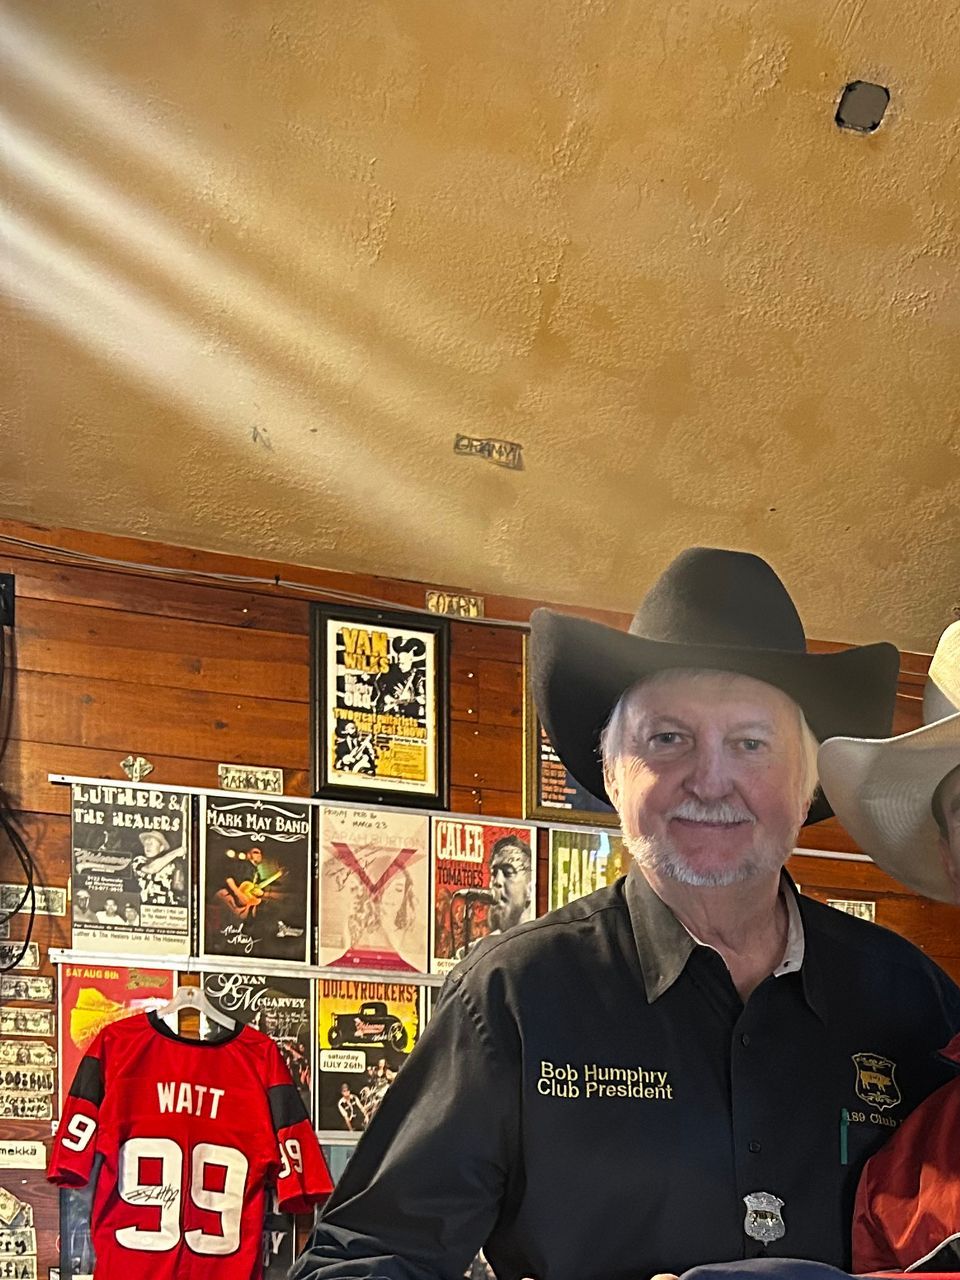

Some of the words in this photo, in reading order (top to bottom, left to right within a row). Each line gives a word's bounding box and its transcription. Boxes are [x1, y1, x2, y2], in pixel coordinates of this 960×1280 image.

[341, 627, 388, 657] VAN
[343, 652, 389, 673] WILKS
[73, 783, 165, 809] LUTHER
[168, 795, 180, 810] &
[74, 808, 104, 825] THE
[112, 811, 180, 832] HEALERS
[206, 809, 242, 828] MARK
[246, 813, 272, 832] MAY
[275, 816, 309, 835] BAND
[436, 821, 484, 864] CALEB
[437, 865, 484, 888] TOMATOES
[66, 968, 82, 977] SAT
[84, 968, 103, 979] AUG
[204, 973, 266, 1002] RYAN
[322, 980, 414, 1002] DOLLYROCKERS
[322, 1060, 342, 1069] JULY
[343, 1061, 364, 1070] 26th
[327, 1051, 359, 1061] saturday
[541, 1060, 578, 1081] Bob
[584, 1064, 667, 1087] Humphry
[156, 1081, 225, 1119] WATT
[537, 1078, 580, 1098] Club
[586, 1080, 673, 1099] President
[61, 1113, 97, 1153] 9
[869, 1113, 897, 1128] Club
[115, 1137, 249, 1255] 99
